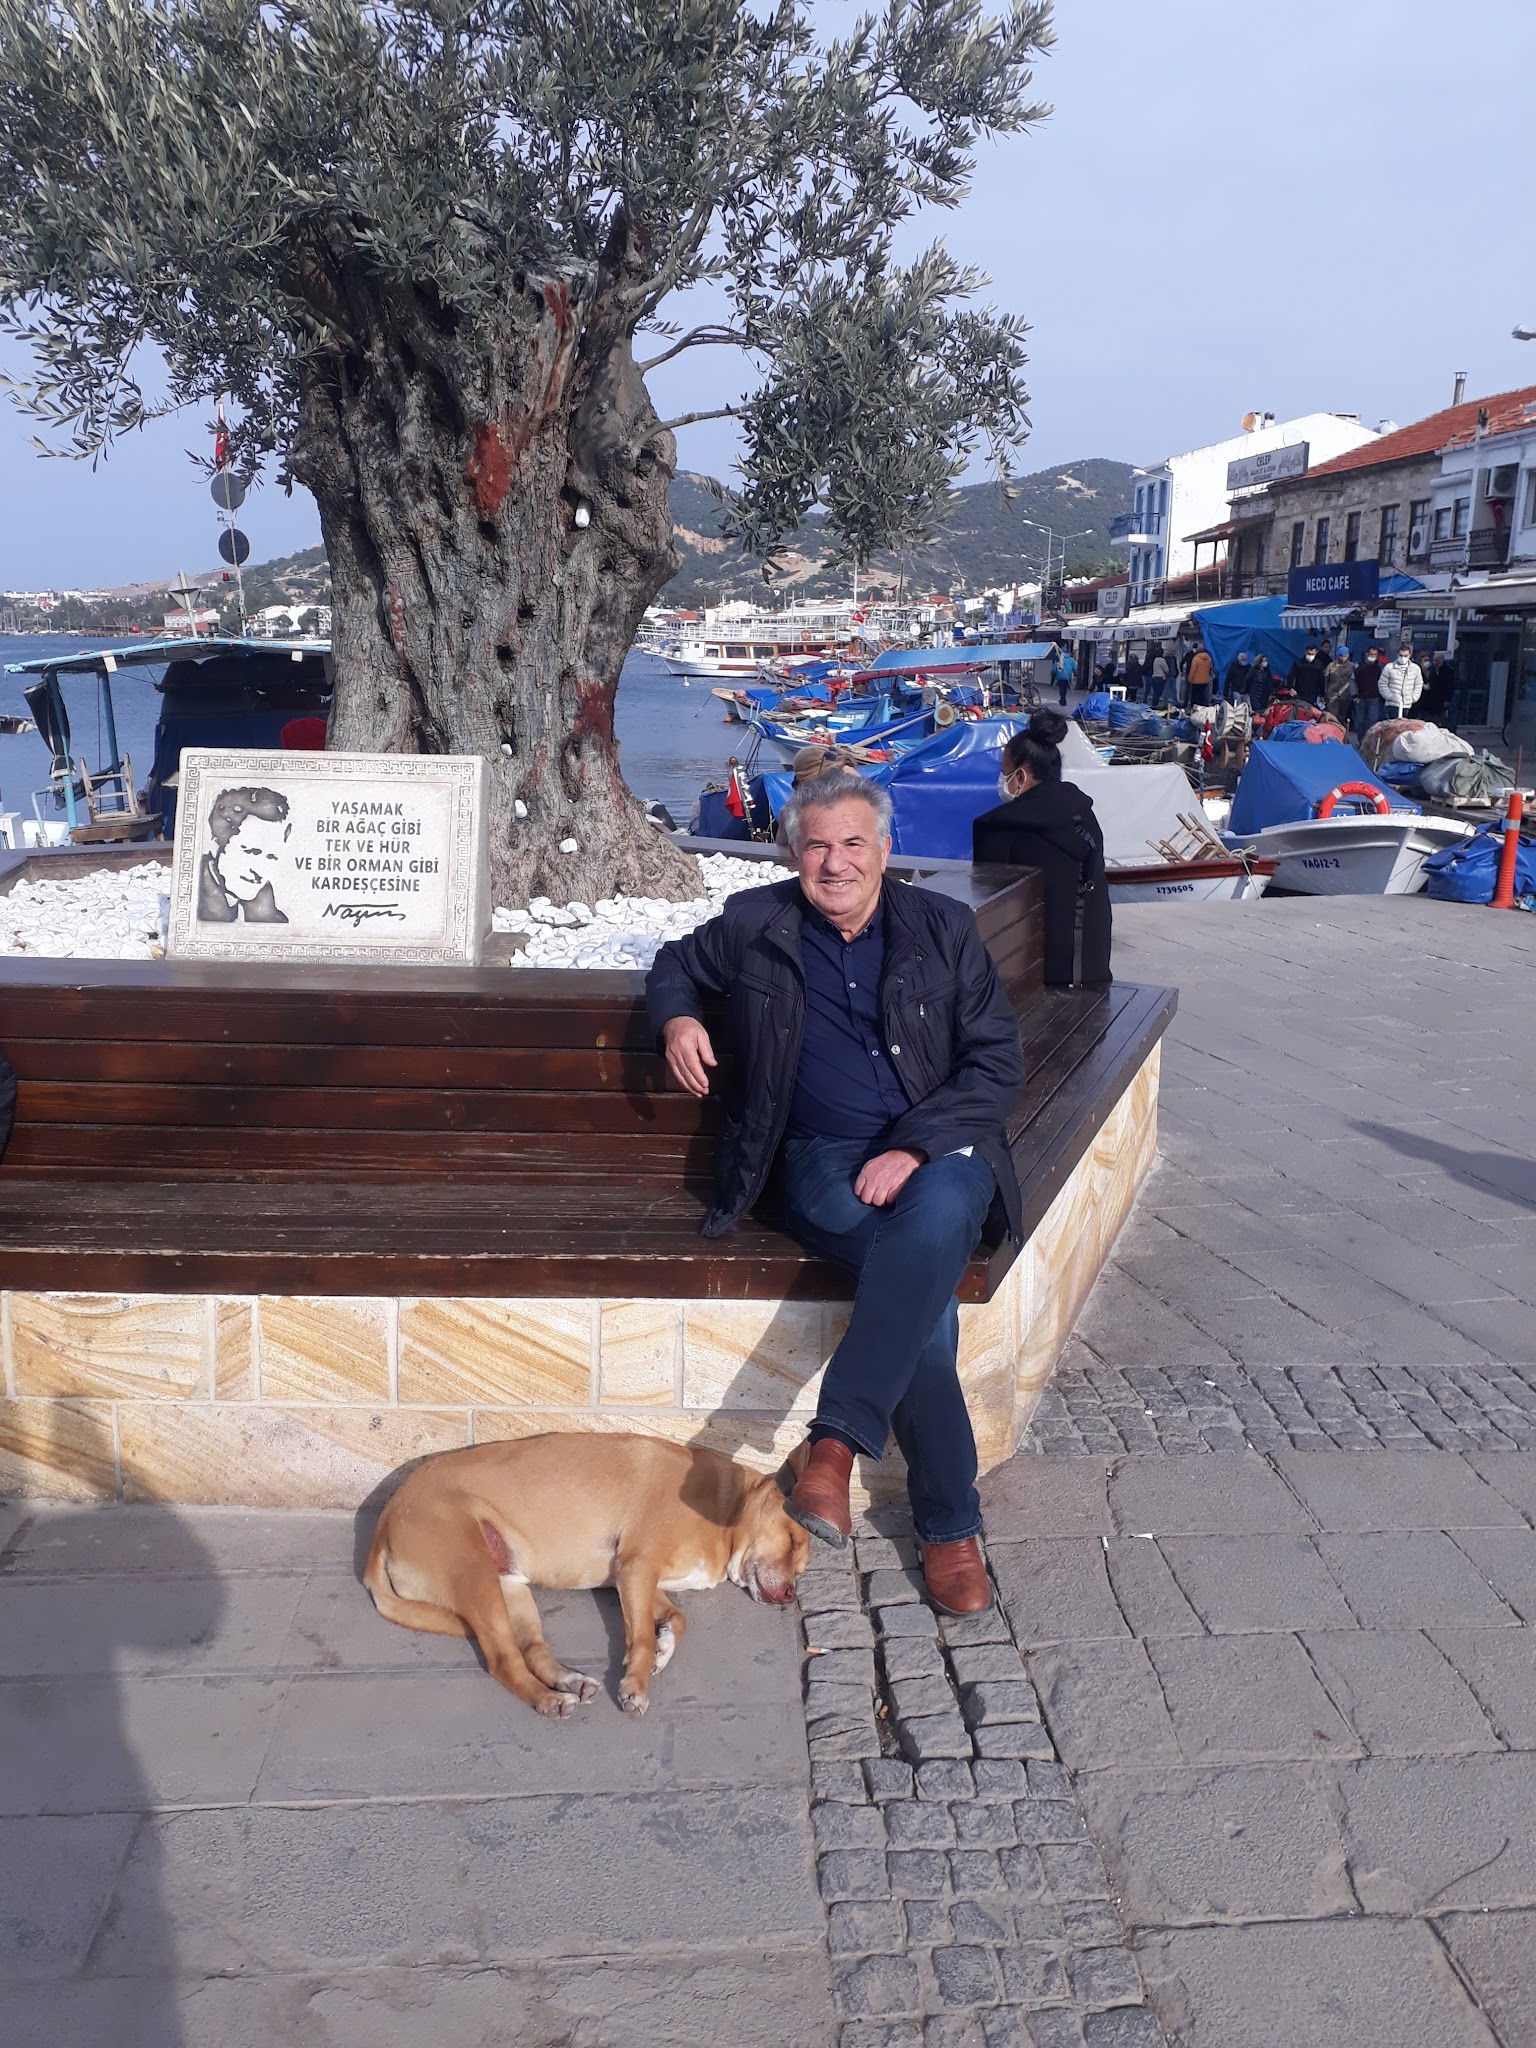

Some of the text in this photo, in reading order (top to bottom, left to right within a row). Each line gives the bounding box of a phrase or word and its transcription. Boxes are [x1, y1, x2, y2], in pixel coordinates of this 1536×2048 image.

[1257, 455, 1271, 467] CELEP
[1305, 575, 1350, 592] NECO CAFE
[331, 801, 404, 818] YAŞAMAK
[316, 816, 421, 838] BİR AĞAÇ GİBİ
[325, 836, 410, 854] TEK VE HÜR
[295, 854, 439, 874] VE BİR ORMAN GİBİ
[311, 874, 420, 895] KARDEŞÇESİNE
